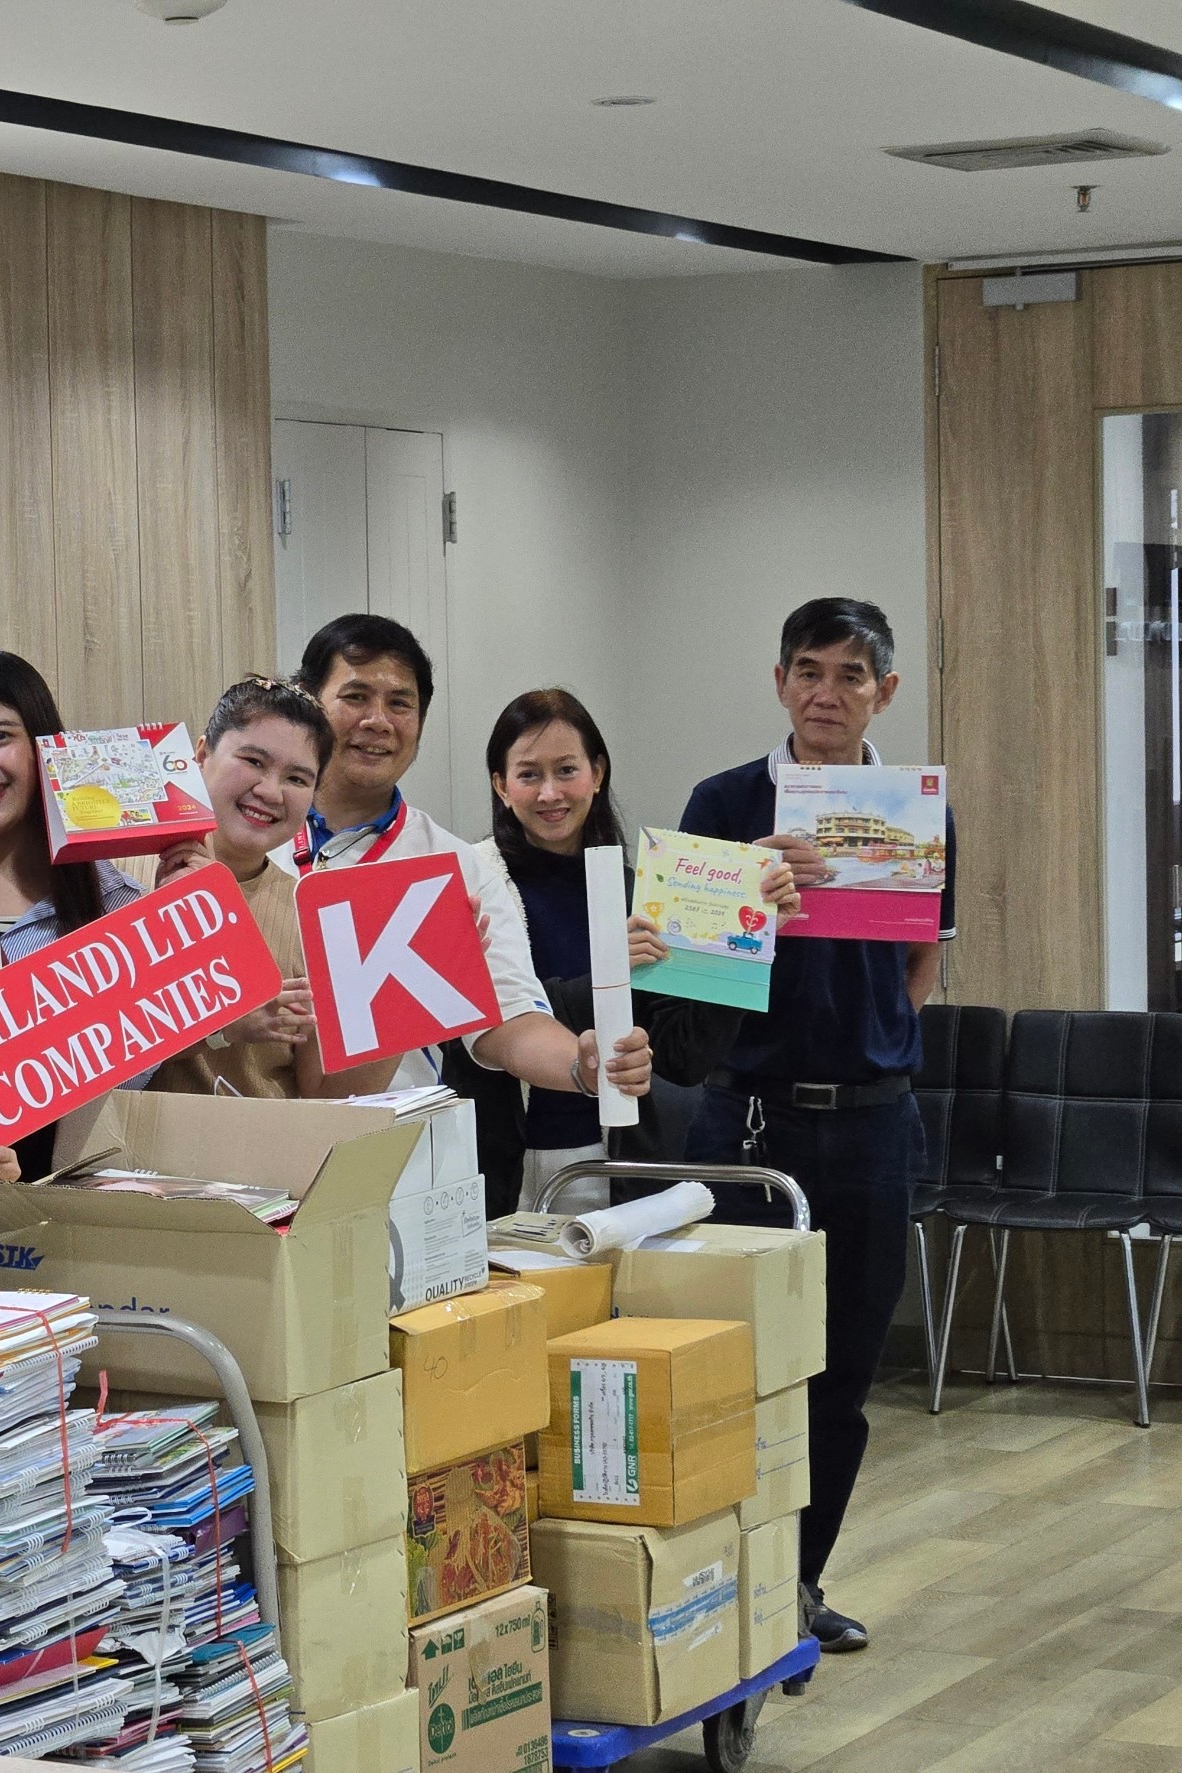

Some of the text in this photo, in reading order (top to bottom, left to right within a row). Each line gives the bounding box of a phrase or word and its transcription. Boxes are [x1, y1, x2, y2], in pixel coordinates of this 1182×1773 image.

[162, 755, 188, 772] 60
[674, 857, 743, 884] Feel good,
[667, 876, 701, 893] Sending
[131, 888, 239, 968] LTD.
[317, 873, 487, 1057] K
[425, 1276, 465, 1302] QUALITY
[423, 1354, 448, 1382] 40
[572, 1395, 581, 1464] BUSINESS FORMS
[627, 1453, 637, 1476] GNR
[430, 1719, 454, 1739] Dettol
